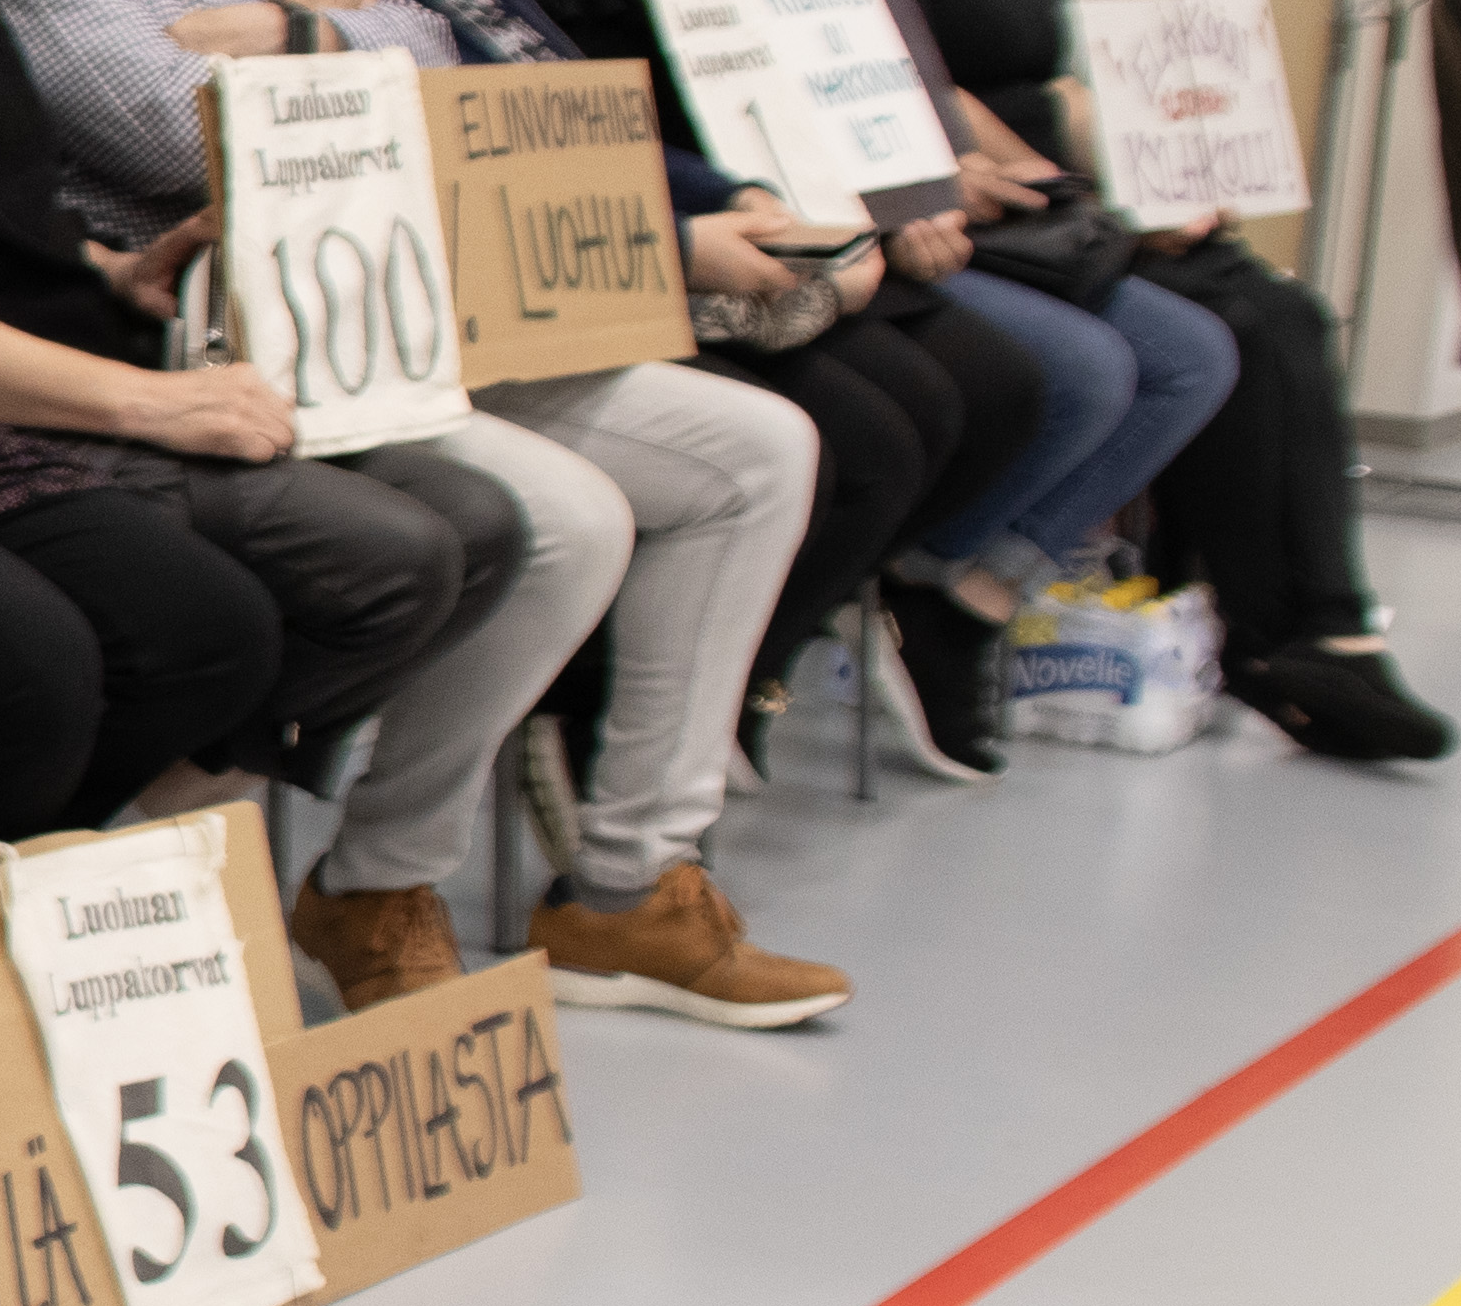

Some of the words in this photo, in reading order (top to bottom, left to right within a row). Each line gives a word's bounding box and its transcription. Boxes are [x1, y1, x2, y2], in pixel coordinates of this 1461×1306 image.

[271, 213, 445, 407] 100
[1016, 650, 1133, 689] Novelle
[57, 887, 189, 941] Luohuan
[47, 947, 232, 1022] Luppakorvat
[116, 1057, 279, 1285] 53
[300, 1006, 573, 1232] OPPILASTA
